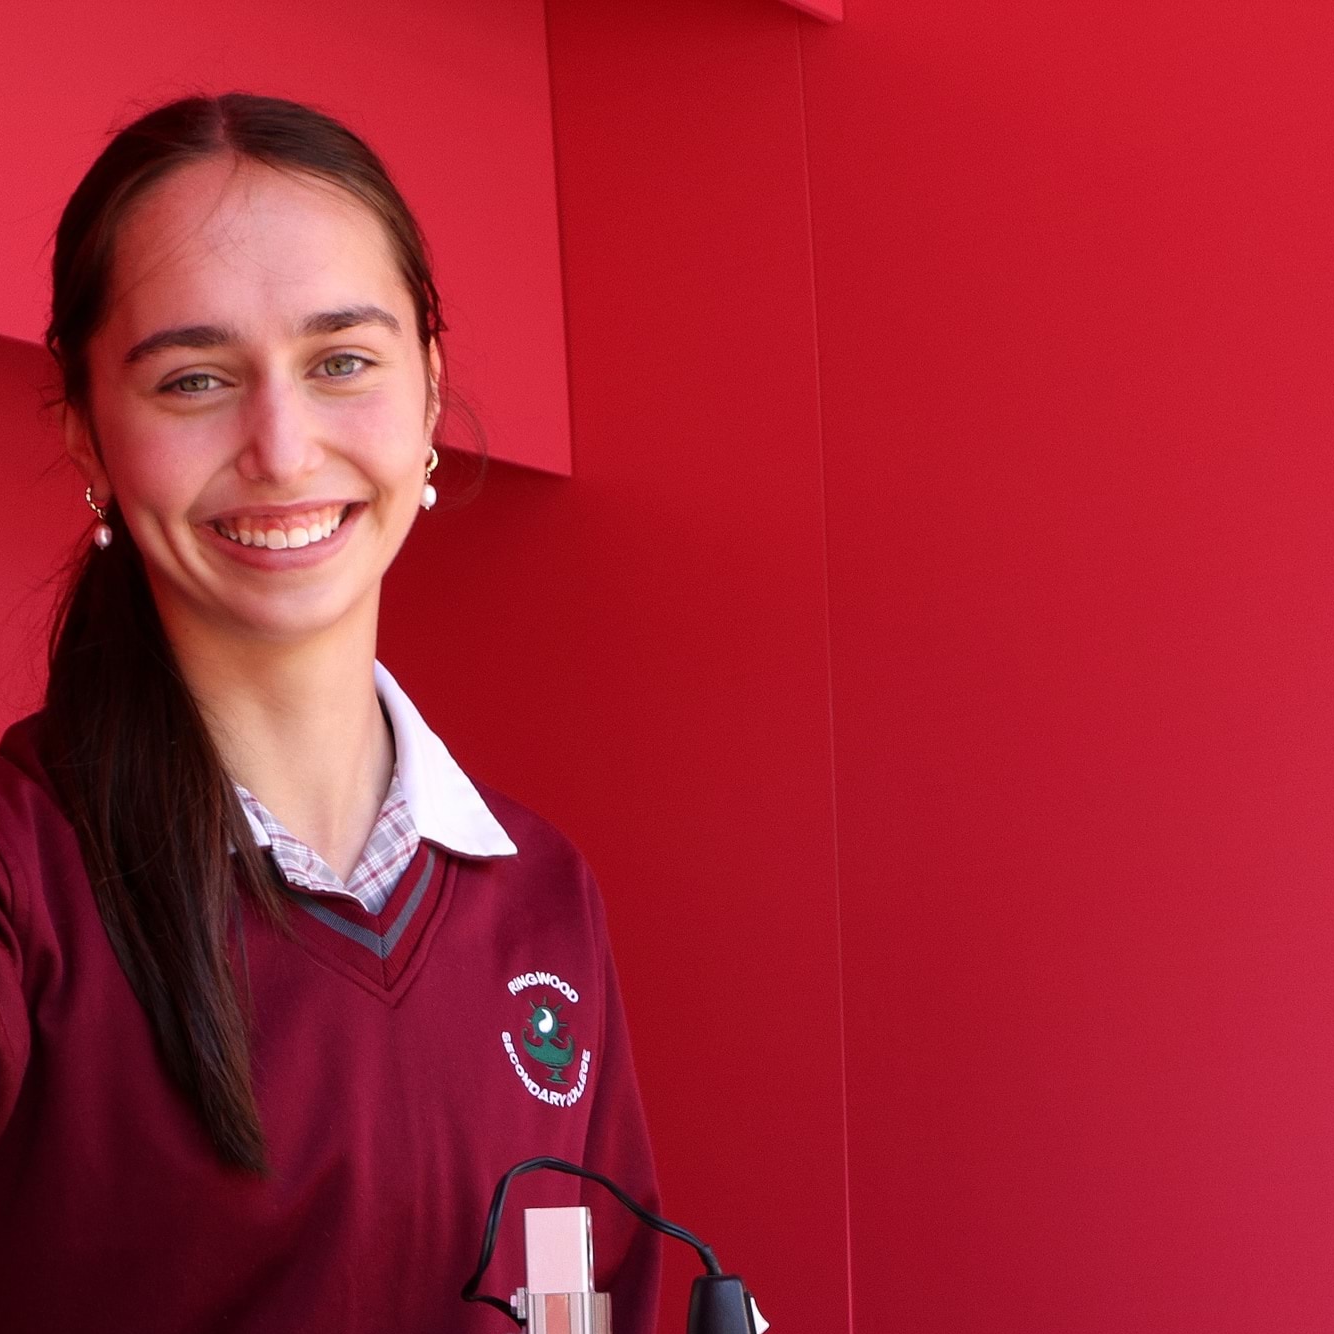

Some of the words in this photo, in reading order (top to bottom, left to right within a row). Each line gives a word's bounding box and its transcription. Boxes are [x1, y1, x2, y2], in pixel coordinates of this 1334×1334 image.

[507, 971, 580, 1004] RINGWOOD
[501, 1031, 566, 1108] SECONDARY
[566, 1048, 591, 1107] COLLEGE
